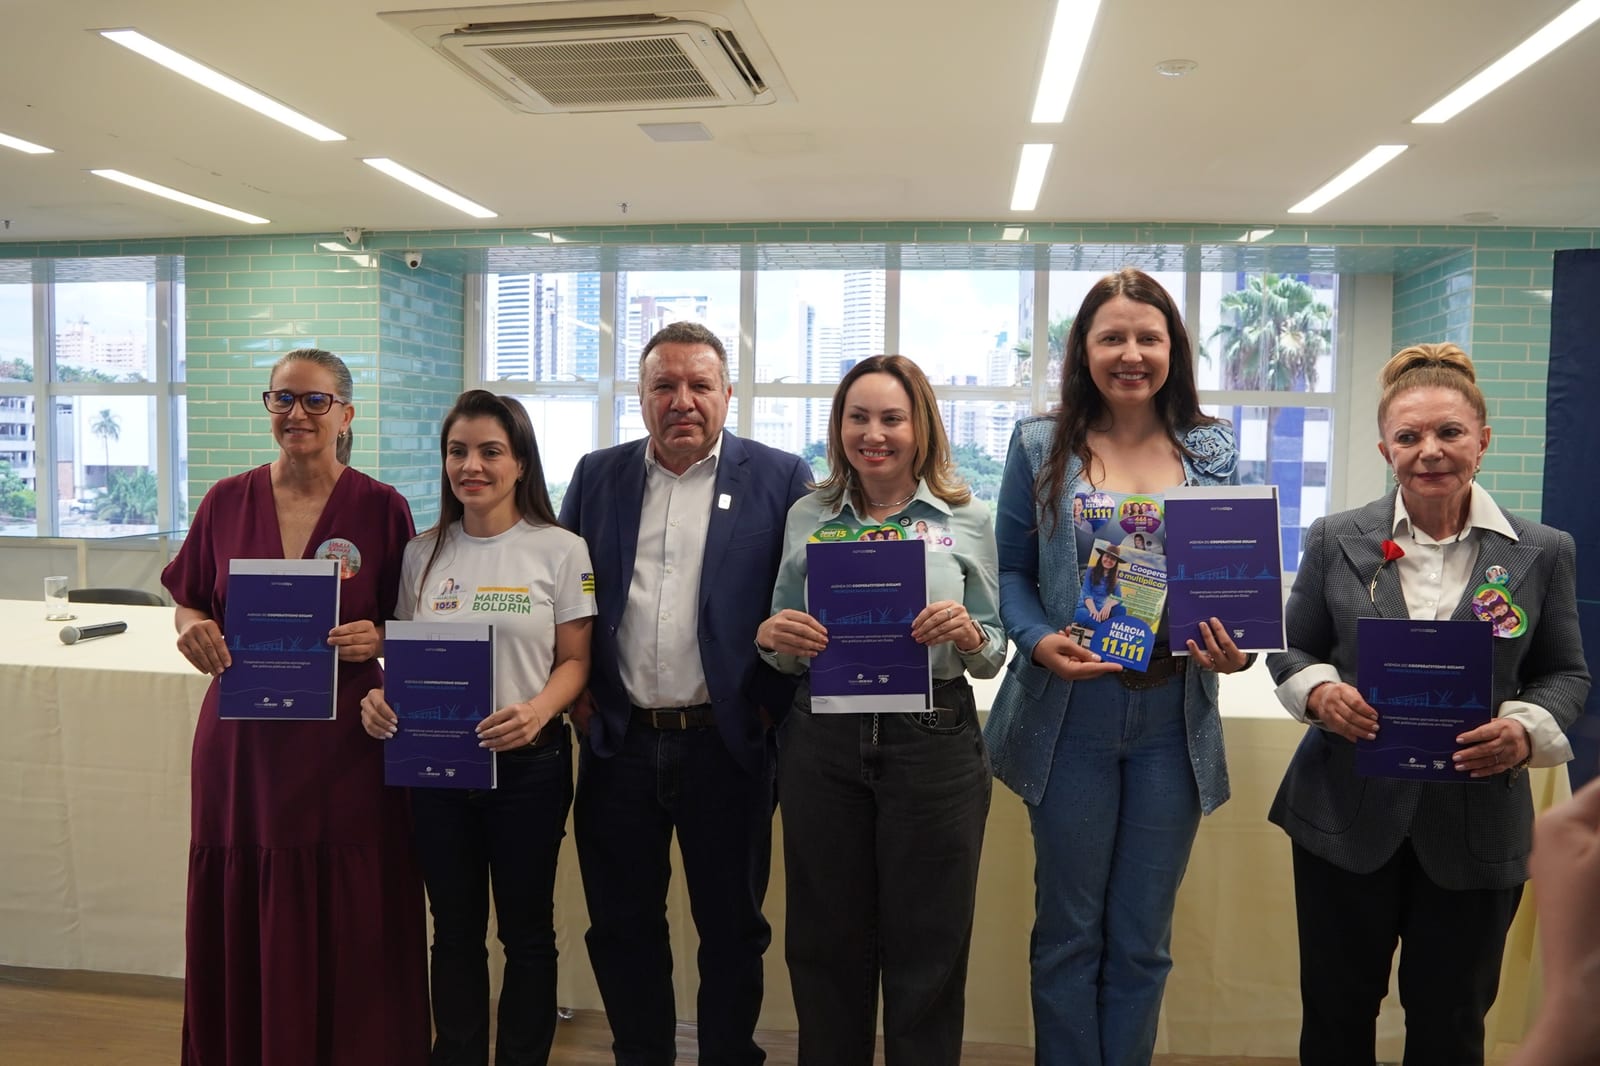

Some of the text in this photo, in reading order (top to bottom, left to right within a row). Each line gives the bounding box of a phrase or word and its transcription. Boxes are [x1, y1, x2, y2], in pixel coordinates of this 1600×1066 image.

[1082, 508, 1112, 519] 11.111
[835, 530, 848, 538] 15
[1124, 573, 1165, 588] multiplicar
[473, 593, 531, 604] MARUSSA
[472, 602, 531, 615] BOLDRIN
[1109, 629, 1134, 642] KELLY
[1111, 622, 1145, 637] NÁRCIA
[1101, 637, 1144, 662] 11.111
